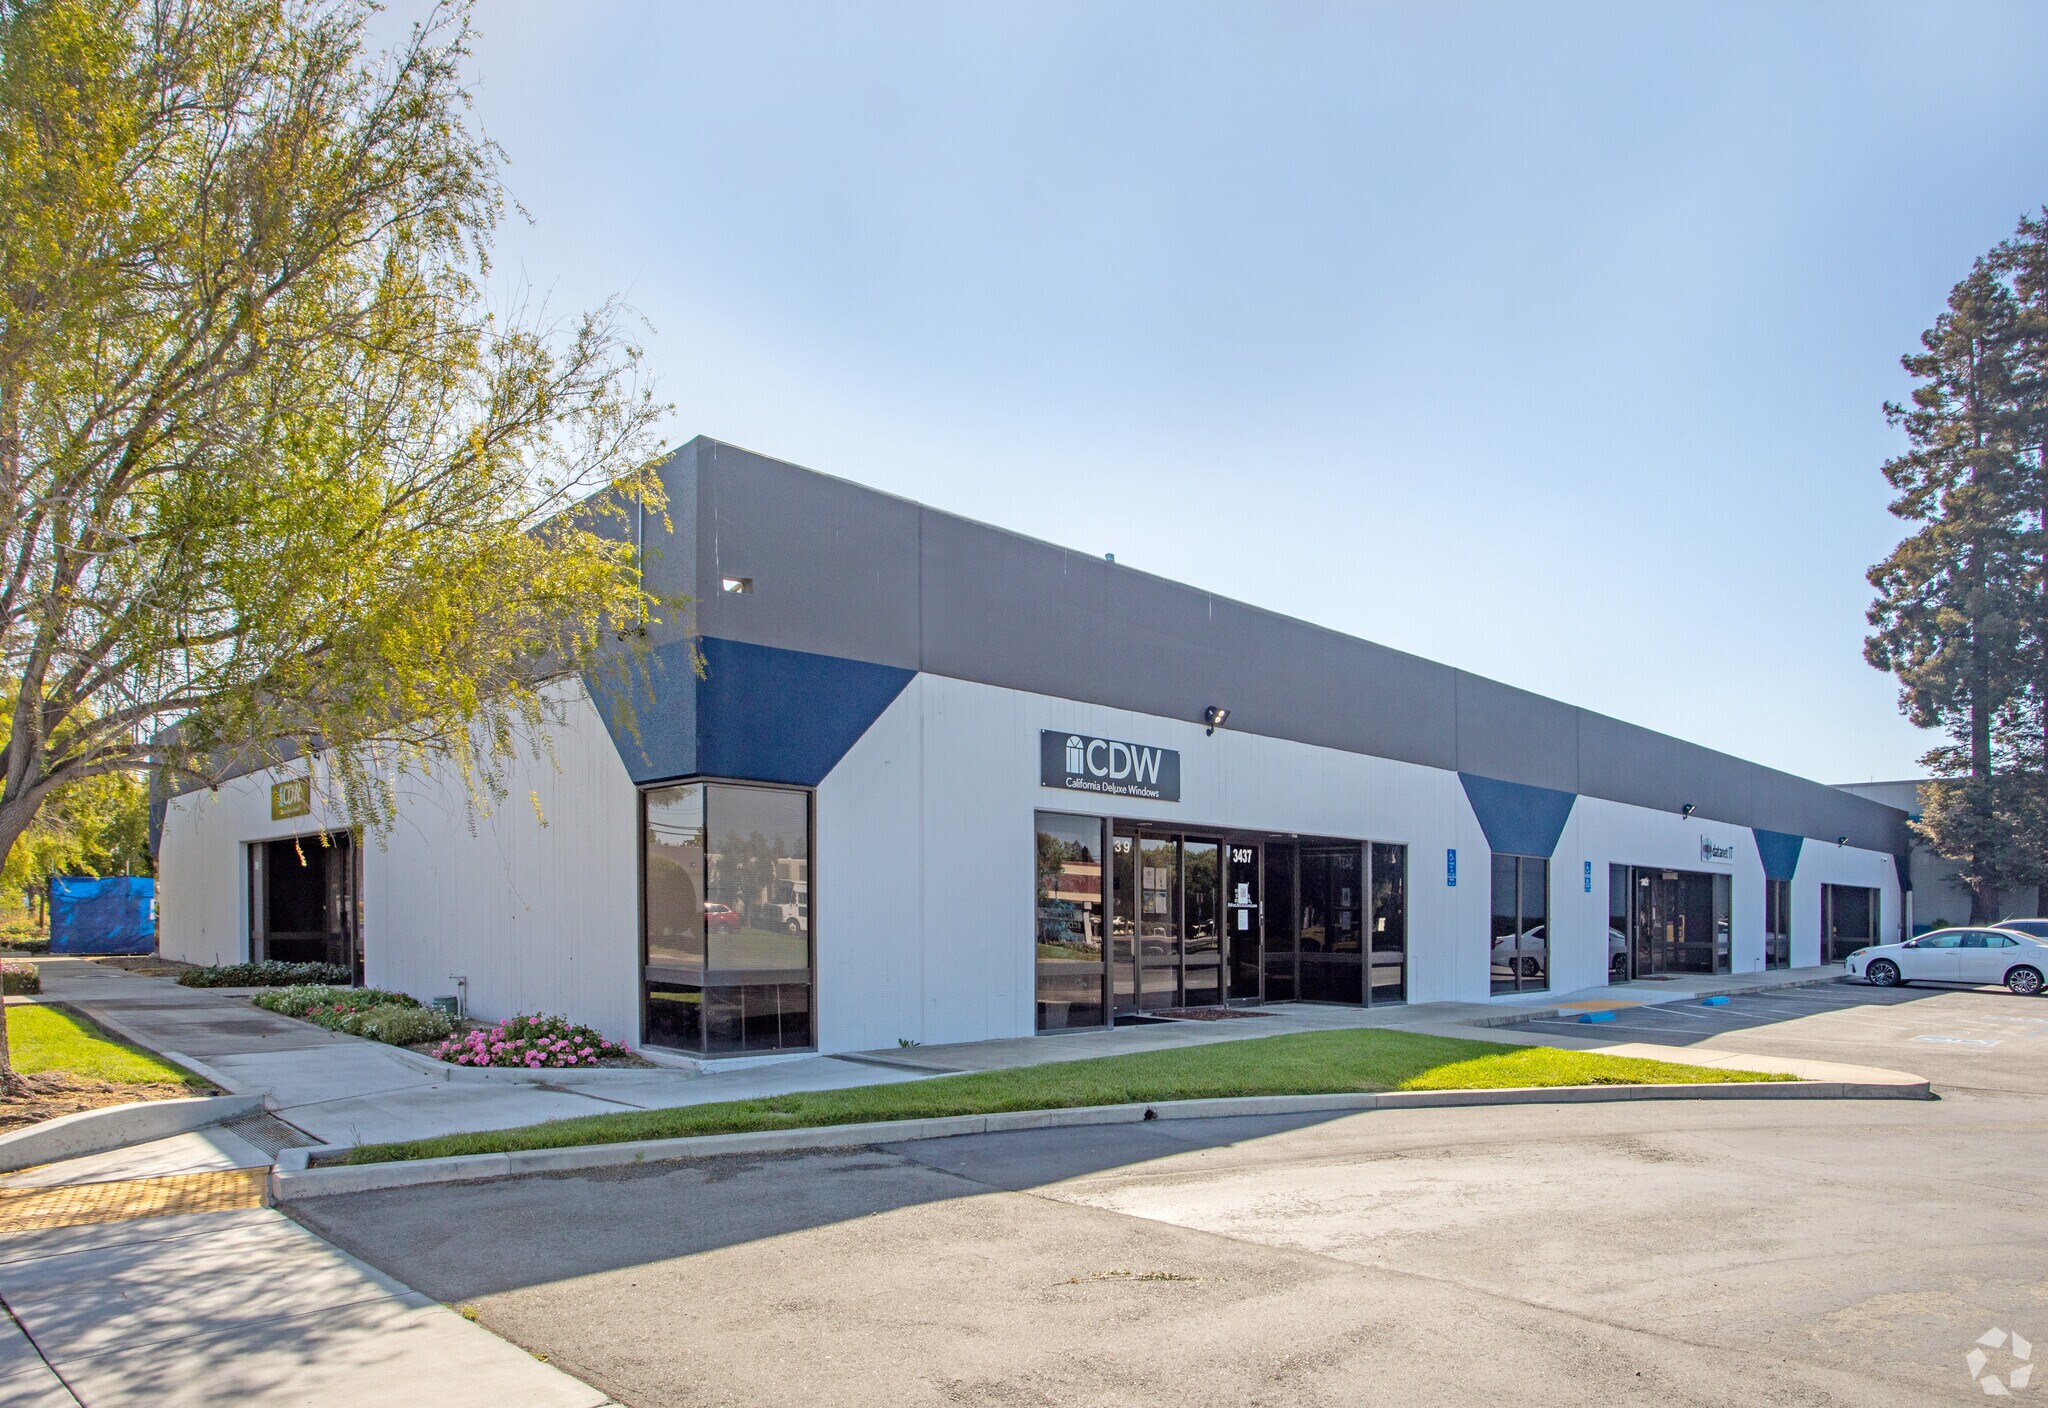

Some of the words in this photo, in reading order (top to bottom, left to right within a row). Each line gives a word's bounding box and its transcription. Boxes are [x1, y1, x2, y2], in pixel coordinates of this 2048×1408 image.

[1086, 739, 1162, 784] CDW
[1065, 777, 1101, 791] California
[1102, 782, 1127, 795] Deluxe
[1128, 785, 1160, 798] Windows
[1232, 848, 1253, 864] 3437
